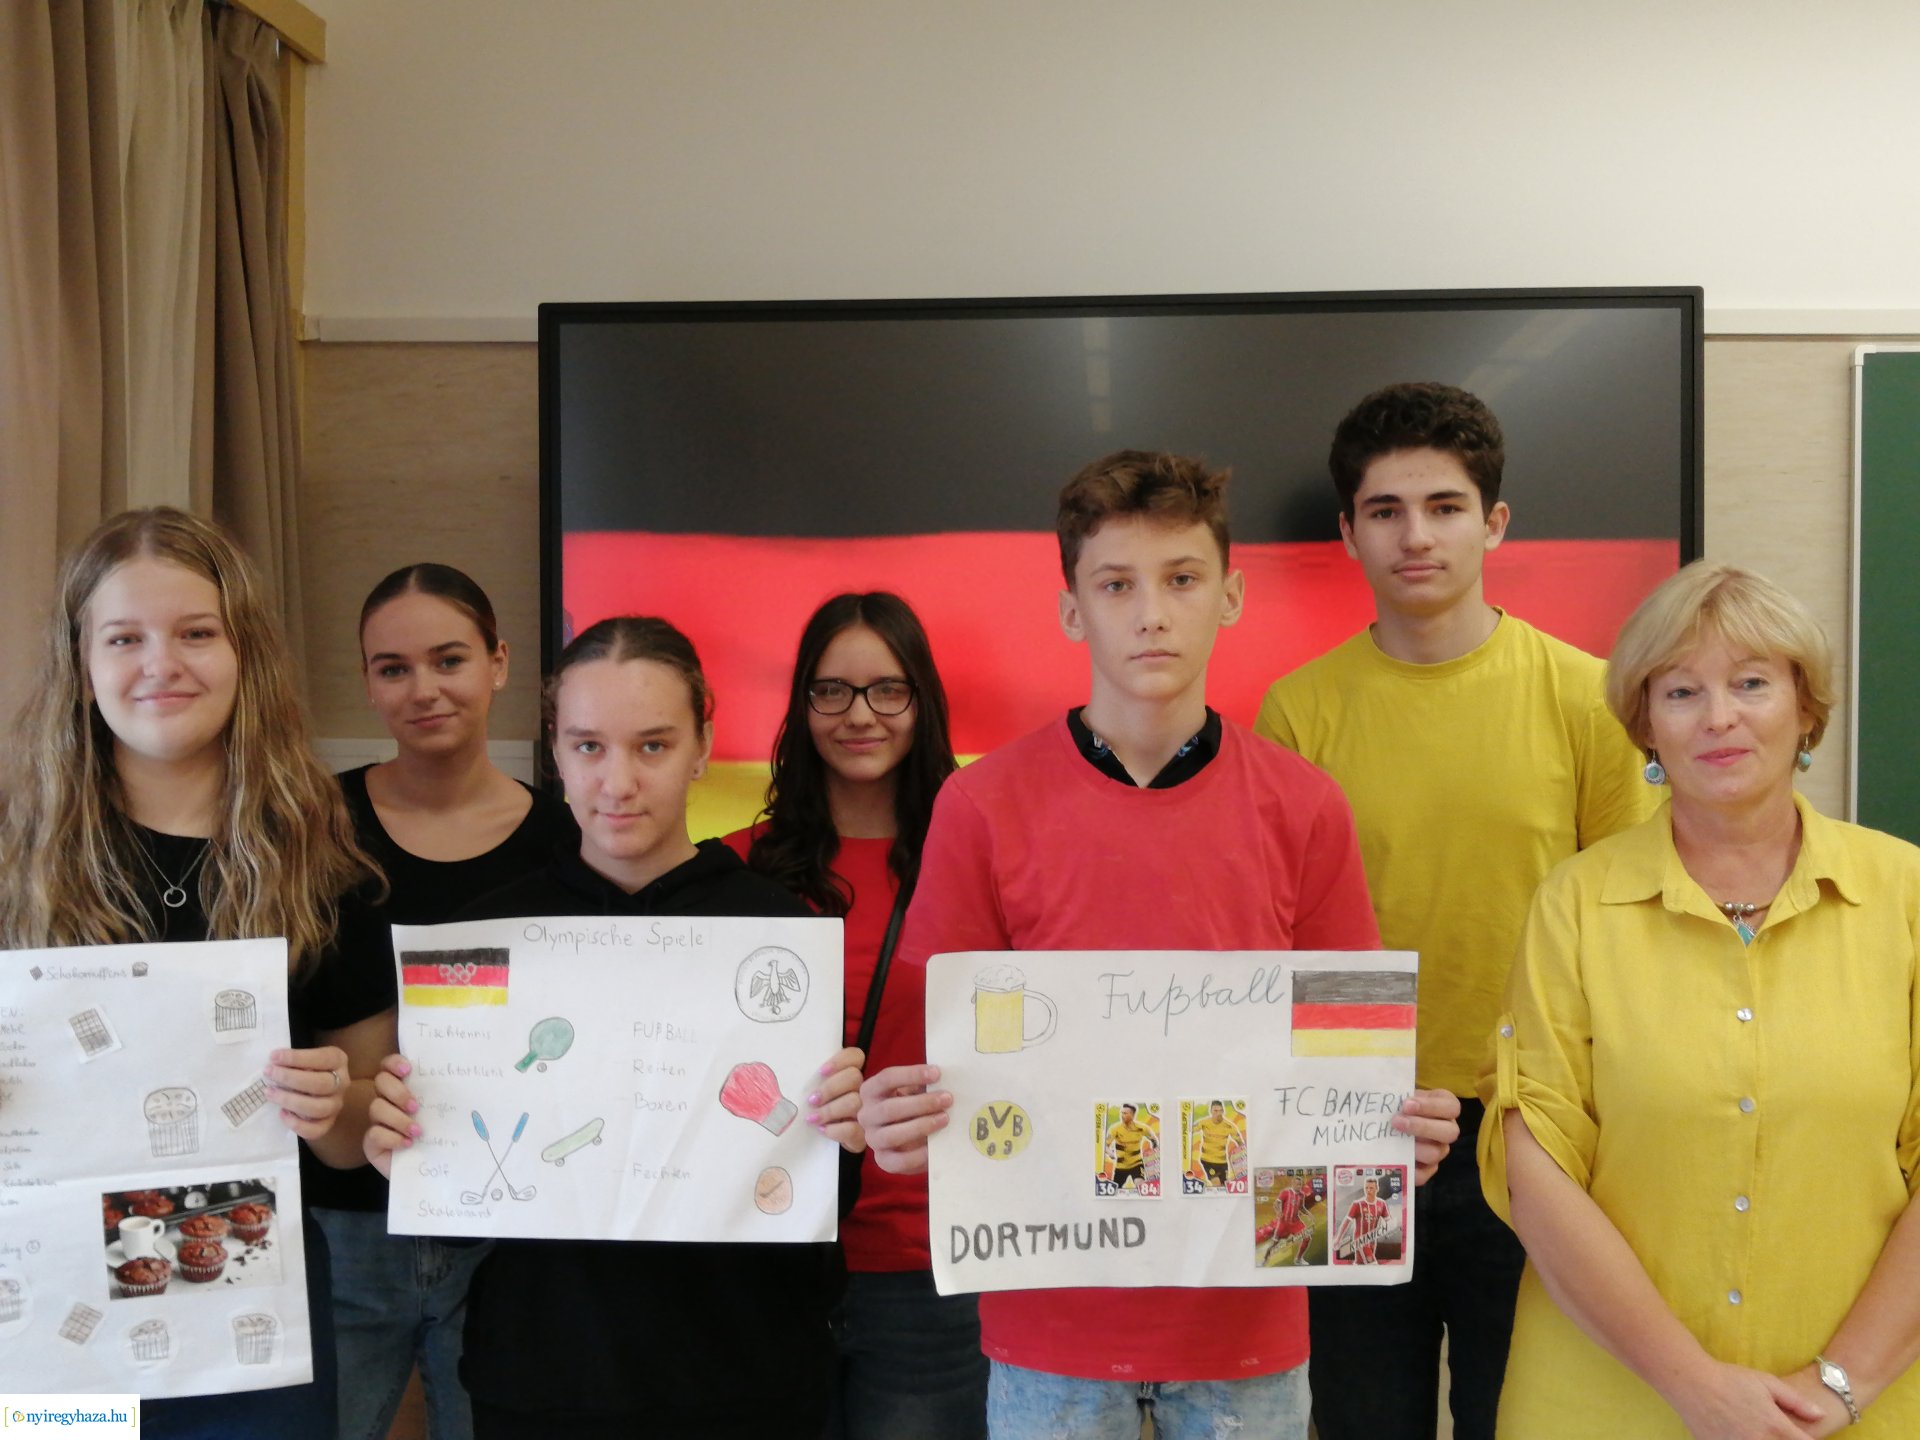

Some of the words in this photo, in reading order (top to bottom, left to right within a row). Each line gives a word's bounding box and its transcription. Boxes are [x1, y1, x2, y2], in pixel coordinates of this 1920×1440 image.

[523, 922, 632, 954] Olympische
[646, 921, 704, 952] Spiele
[1098, 965, 1285, 1037] Fußball
[632, 1058, 687, 1076] Reiten
[634, 1091, 688, 1112] Boxen
[1274, 1086, 1315, 1116] FC
[976, 1105, 1024, 1141] BVB
[1099, 1183, 1116, 1195] 36
[1141, 1182, 1157, 1195] 84
[1186, 1181, 1203, 1193] 34
[1229, 1180, 1246, 1193] 70
[951, 1217, 1146, 1264] DORTMUND
